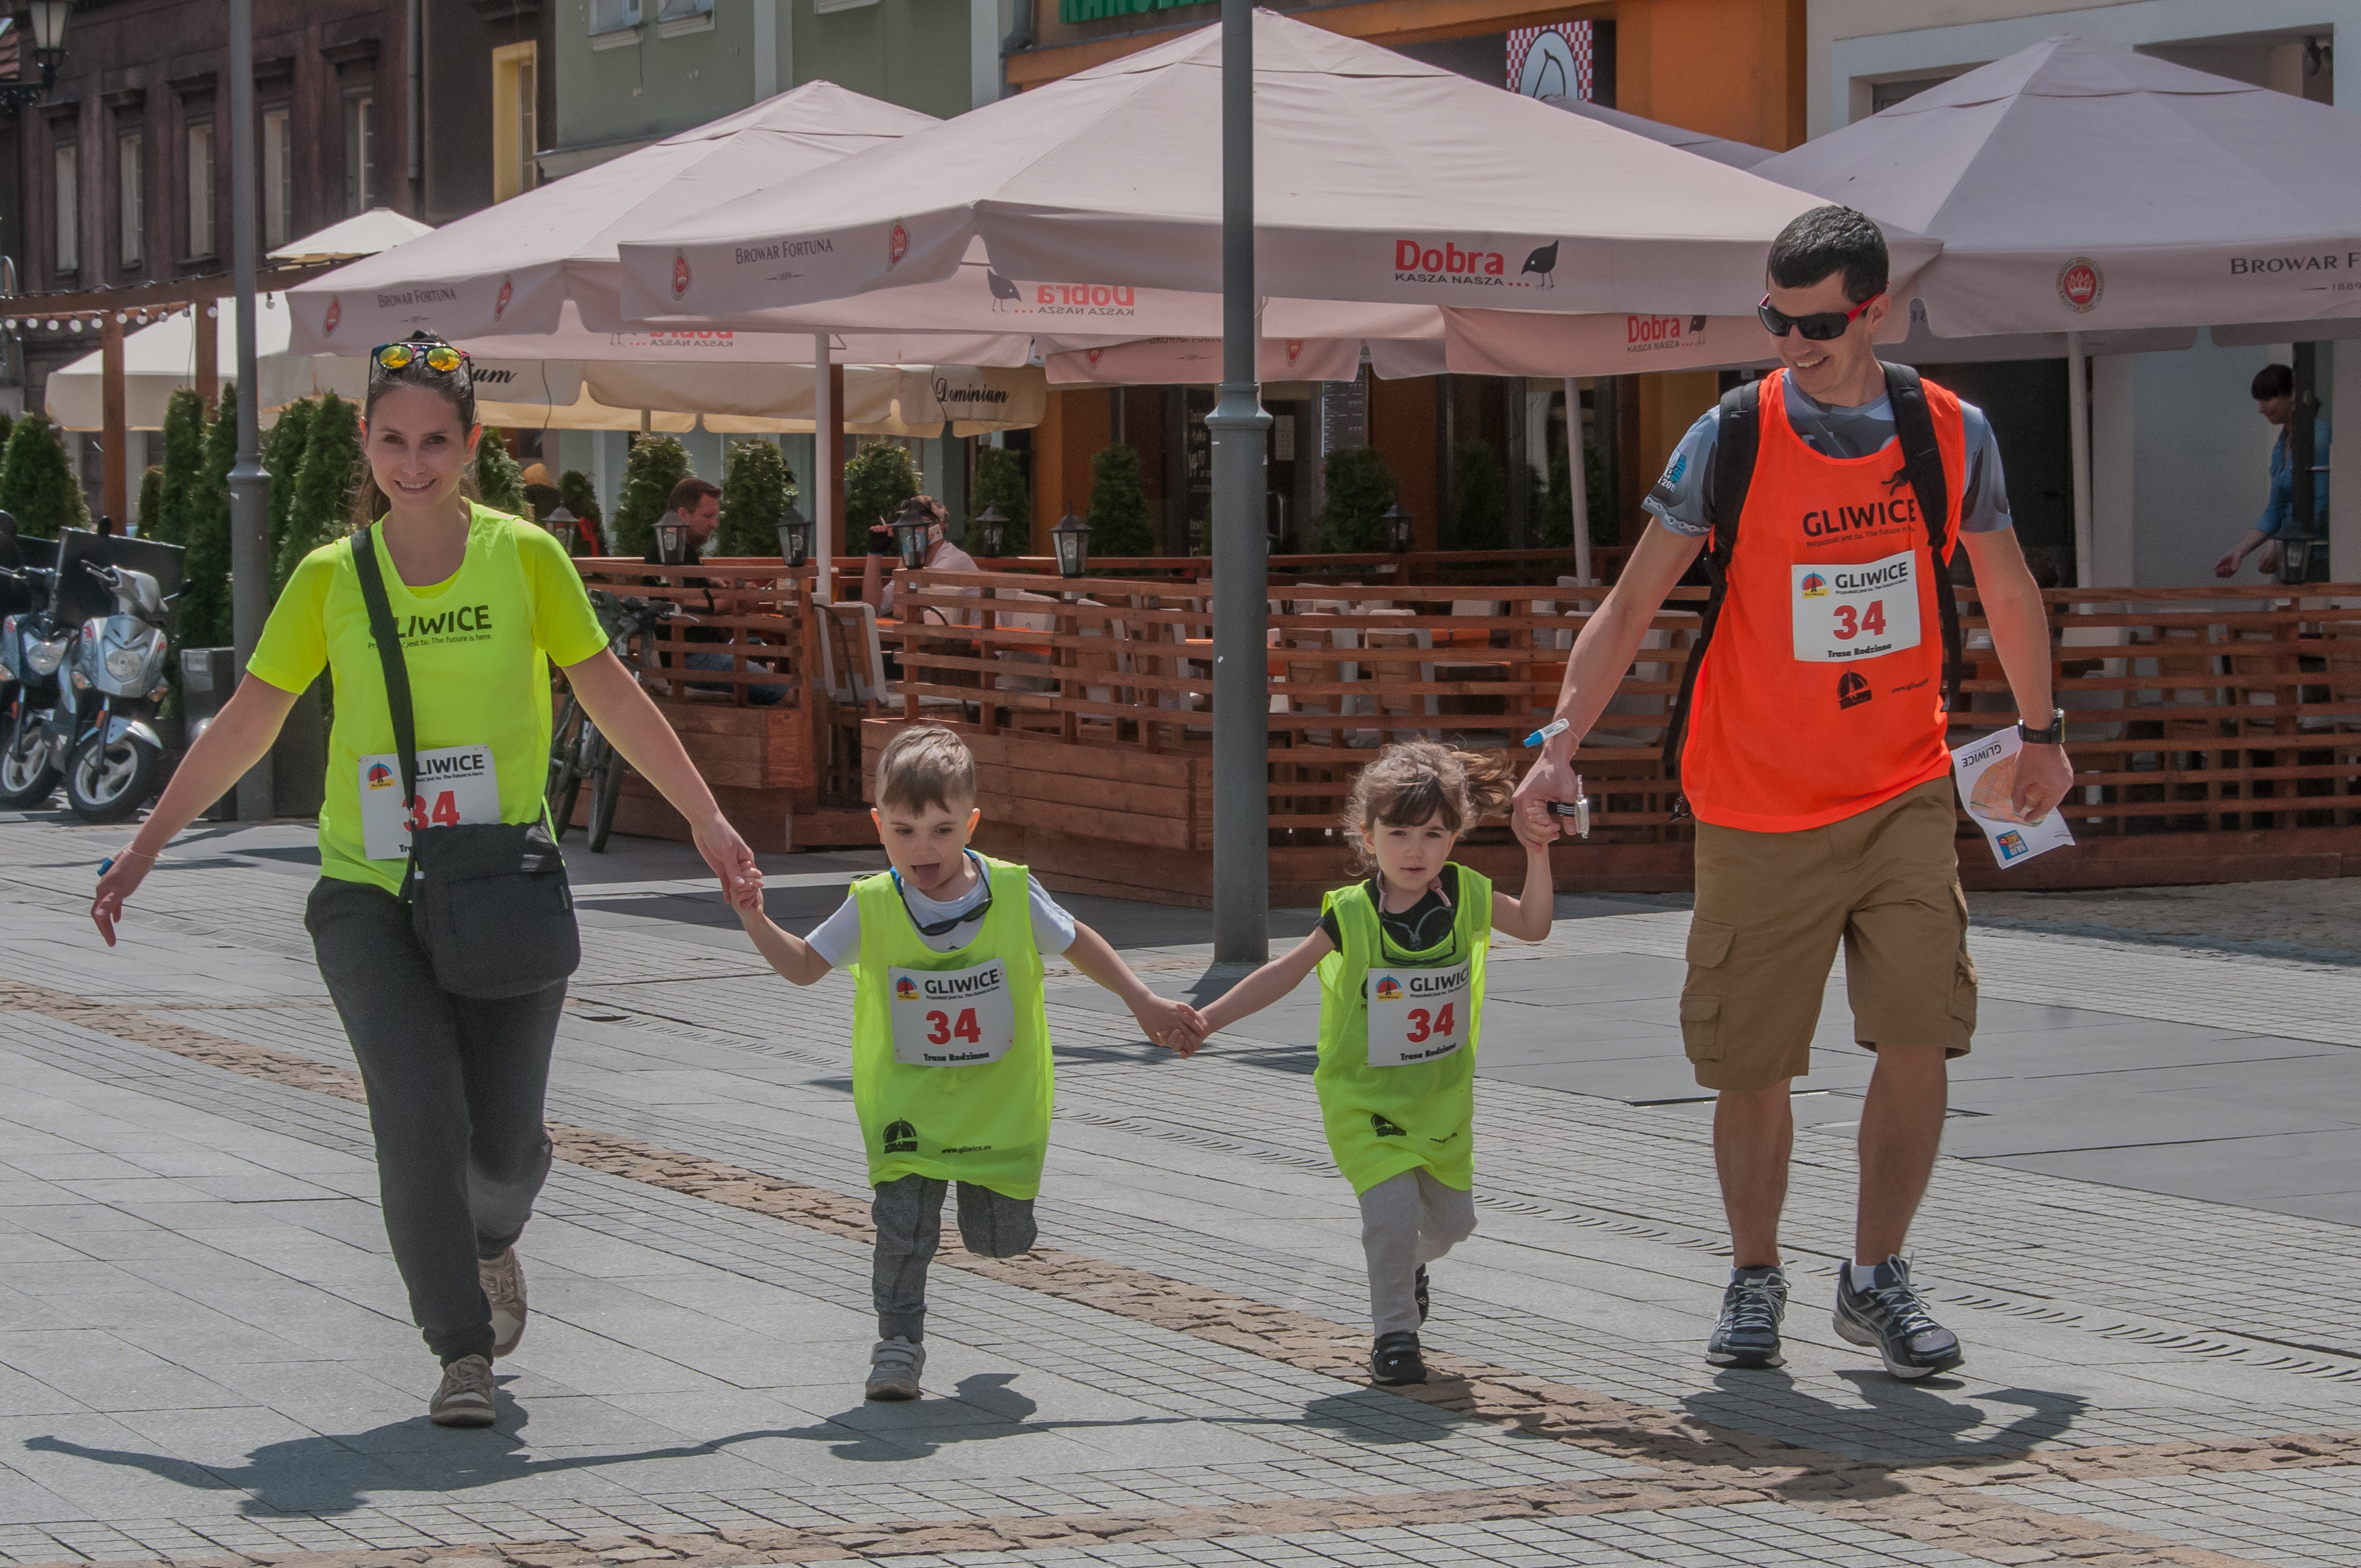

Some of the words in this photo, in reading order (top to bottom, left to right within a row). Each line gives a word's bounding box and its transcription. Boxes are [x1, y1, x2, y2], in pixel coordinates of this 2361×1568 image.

[735, 244, 780, 265] BROWAR
[782, 239, 834, 258] FORTUNA
[1395, 240, 1505, 275] Dobra
[2230, 255, 2339, 275] BROWAR
[1395, 273, 1448, 284] KASZA
[378, 292, 414, 307] BROWAR
[415, 289, 456, 303] FORTUNA
[1627, 314, 1681, 343] Dobra
[1627, 343, 1652, 353] KASZA
[1802, 499, 1916, 537] GLIWICE
[1834, 561, 1908, 589] GLIWICE
[369, 605, 493, 638] LIWICE
[1833, 600, 1887, 640] 34
[445, 635, 468, 643] future
[1854, 643, 1893, 656] Rodzinna
[415, 754, 485, 776] LIWICE
[1962, 744, 2002, 768] GLIWICE
[402, 790, 461, 833] 34
[924, 968, 1000, 994] GLIWICE
[926, 1008, 981, 1046] 34
[1406, 1001, 1455, 1044] 34
[923, 1053, 947, 1061] Trasa
[949, 1052, 989, 1061] Rodzinna
[1400, 1052, 1423, 1060] Trasa
